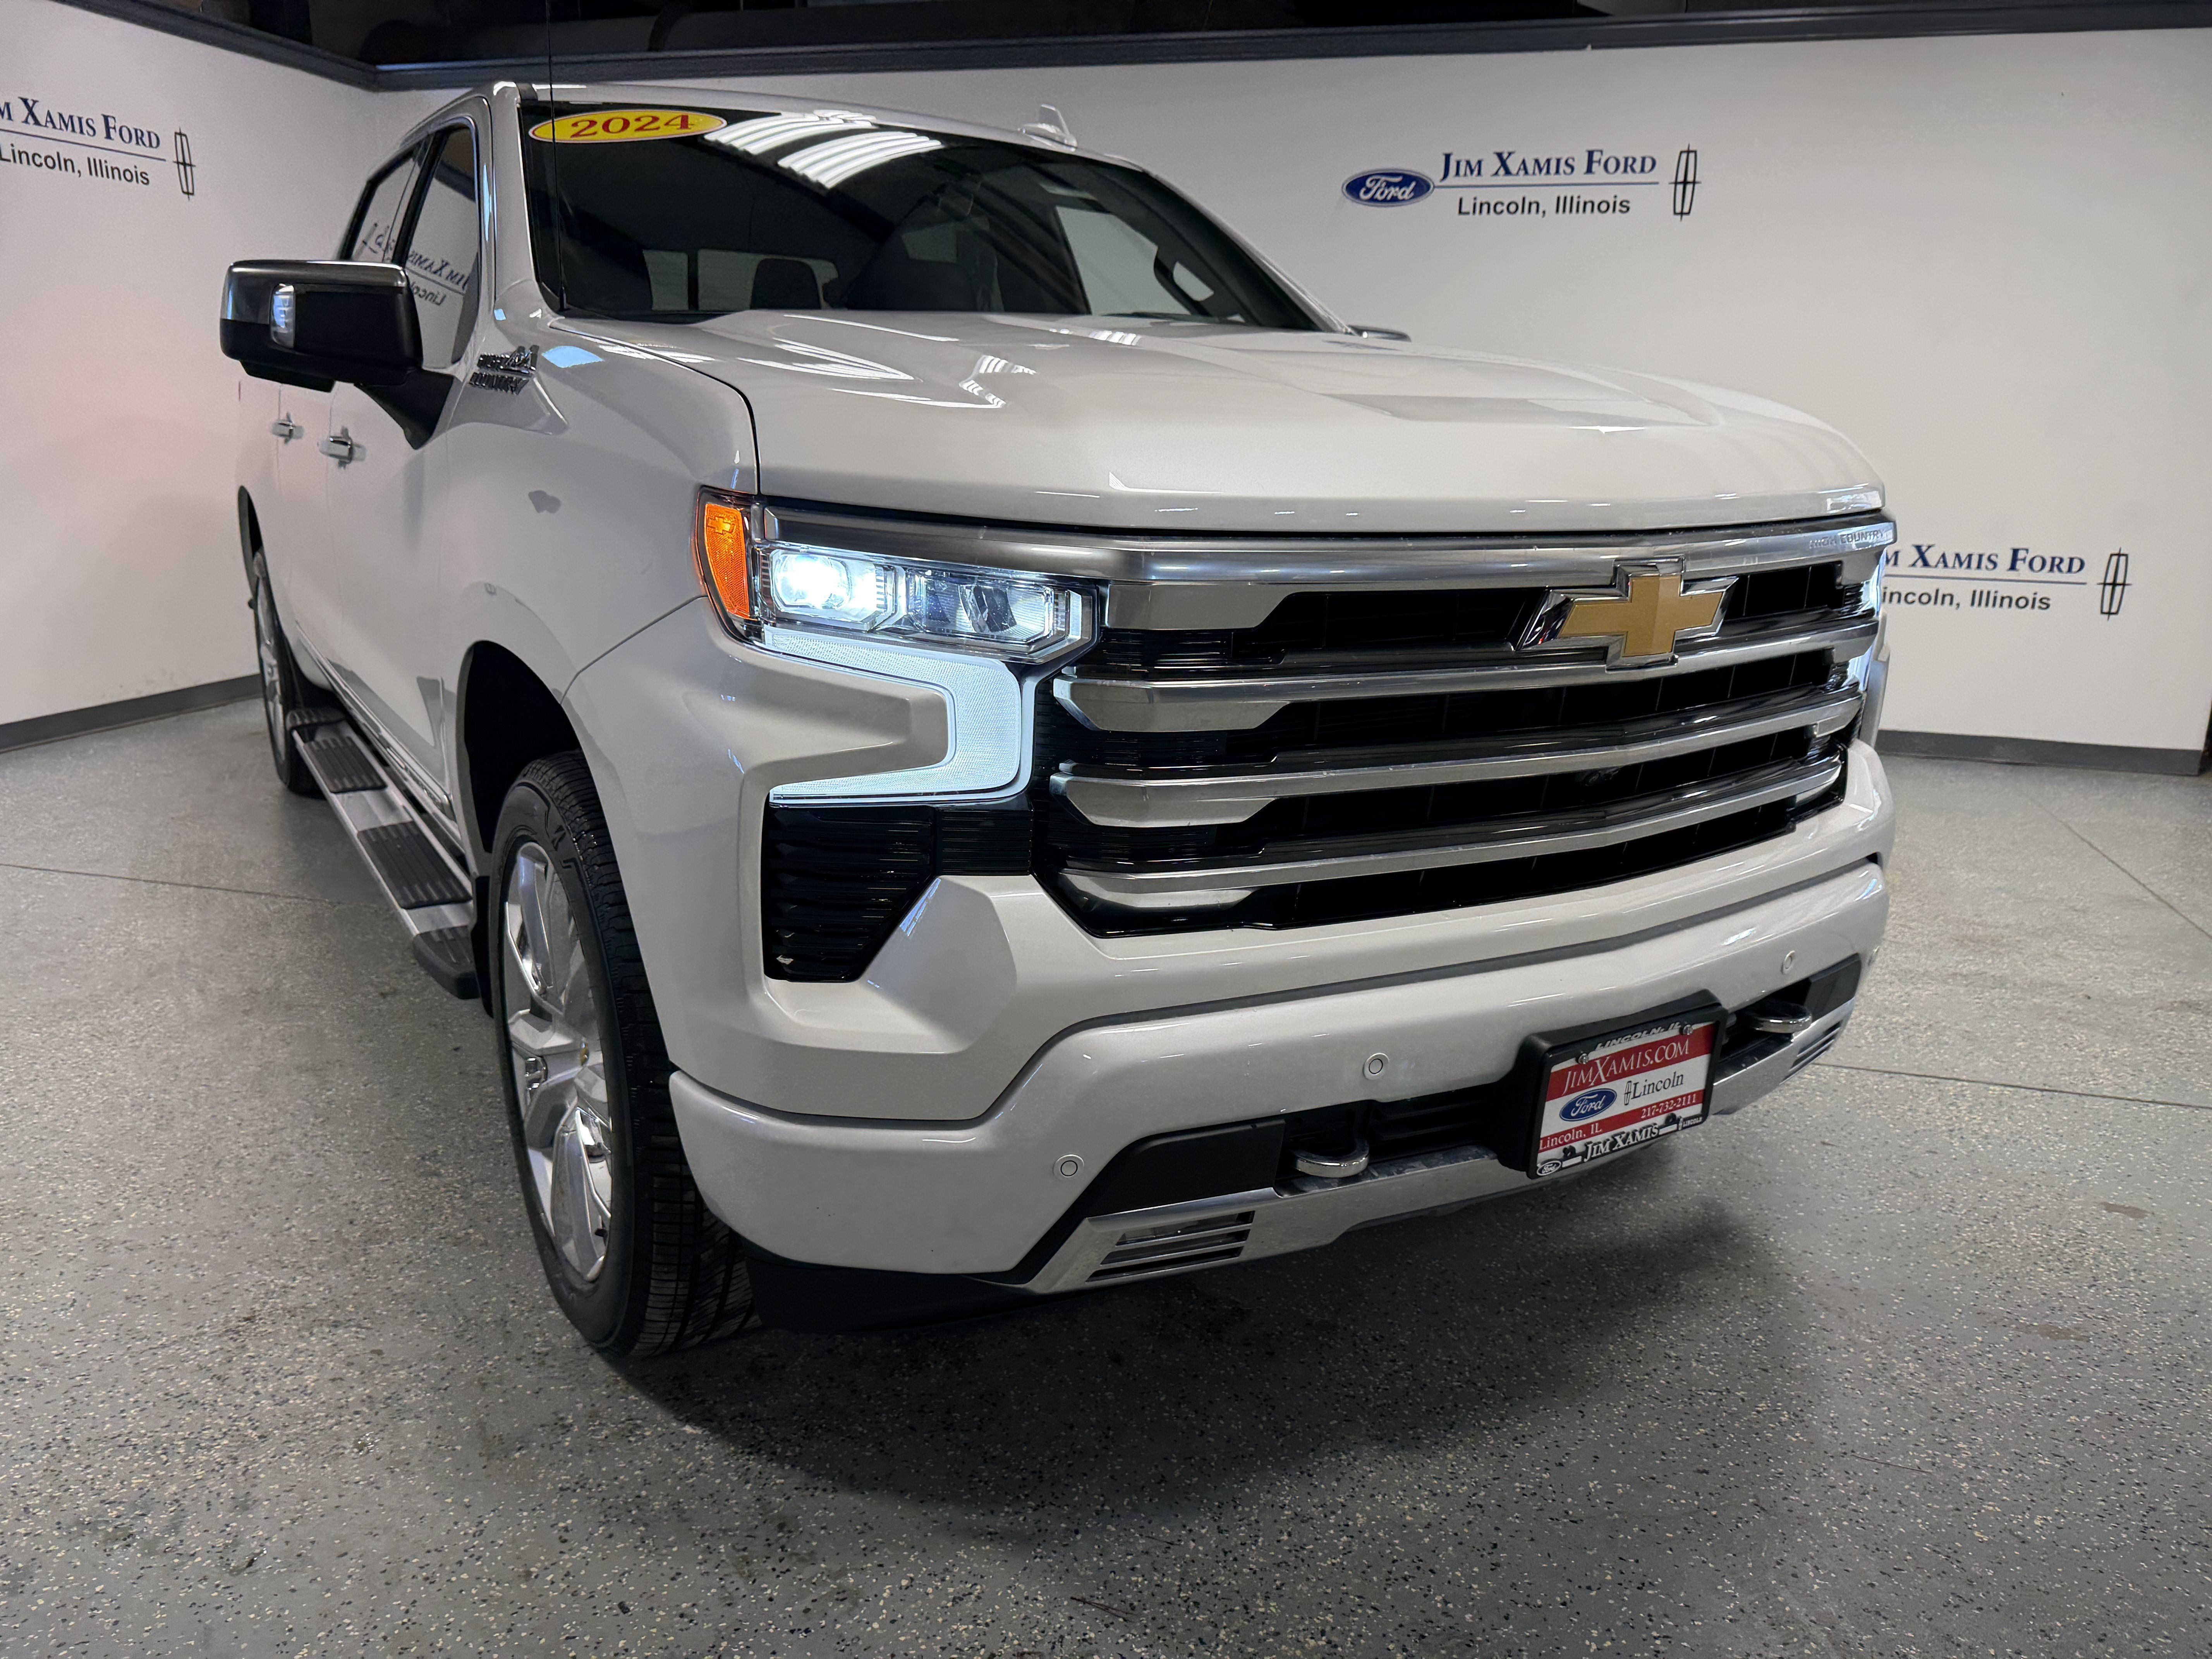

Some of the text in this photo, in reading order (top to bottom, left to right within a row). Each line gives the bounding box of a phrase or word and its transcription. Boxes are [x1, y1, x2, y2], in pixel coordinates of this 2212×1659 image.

[18, 96, 97, 137] XAMIS
[101, 113, 160, 149] FORD
[570, 114, 695, 139] 2024
[87, 156, 150, 185] Illinois
[1439, 148, 1657, 183] JIM XAMIS FORD
[1359, 174, 1416, 201] Ford
[1457, 194, 1631, 218] Lincoln, Illinois
[1907, 543, 1999, 571] XAMIS
[2006, 546, 2086, 574] FORD
[1881, 586, 2051, 611] incoln, Illinois
[1562, 1038, 1690, 1095] JIMXAMIS.COM
[1631, 1071, 1684, 1099] Lincoln
[1570, 1093, 1606, 1117] Ford
[1640, 1093, 1697, 1119] 217-732-2111
[1590, 1122, 1602, 1135] IL
[1583, 1123, 1659, 1162] JIM XAMIS
